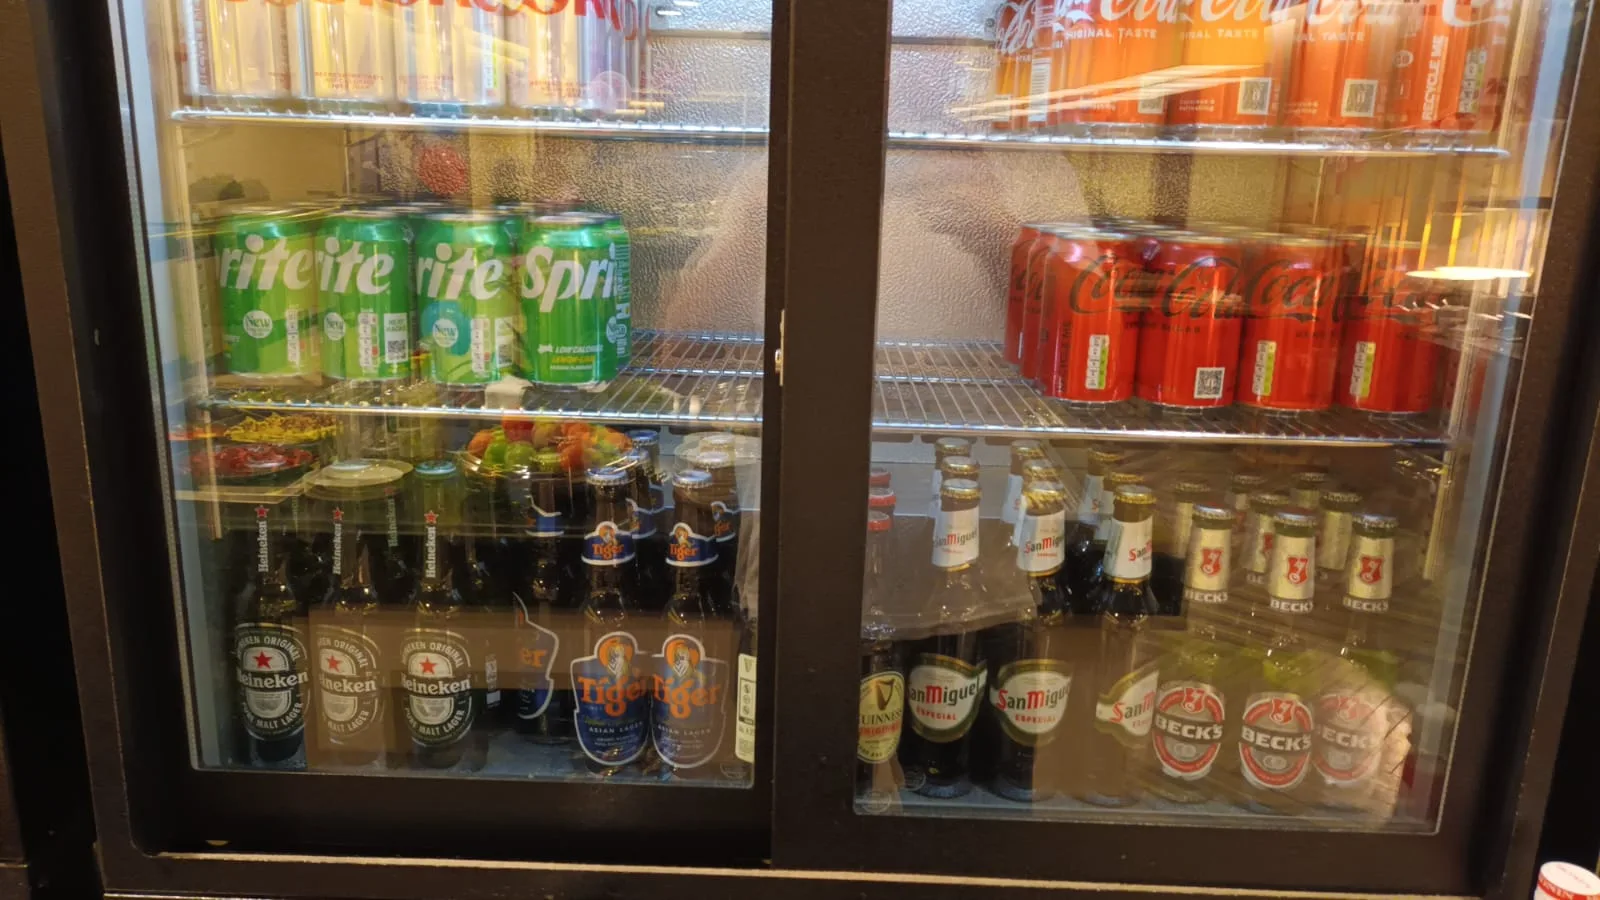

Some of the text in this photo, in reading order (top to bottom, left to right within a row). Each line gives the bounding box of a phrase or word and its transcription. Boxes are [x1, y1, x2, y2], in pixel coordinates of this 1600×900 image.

[1118, 28, 1157, 39] TASTE
[219, 234, 314, 290] rite
[316, 237, 395, 294] rite
[416, 242, 504, 300] rite
[521, 241, 616, 313] Spri
[257, 520, 269, 573] Heineken
[332, 523, 342, 575] Heineken
[426, 526, 436, 578] Heineken
[592, 541, 625, 560] Tiger
[1023, 533, 1065, 555] SanMig
[319, 676, 377, 693] ineken
[995, 684, 1071, 711] SanMigu
